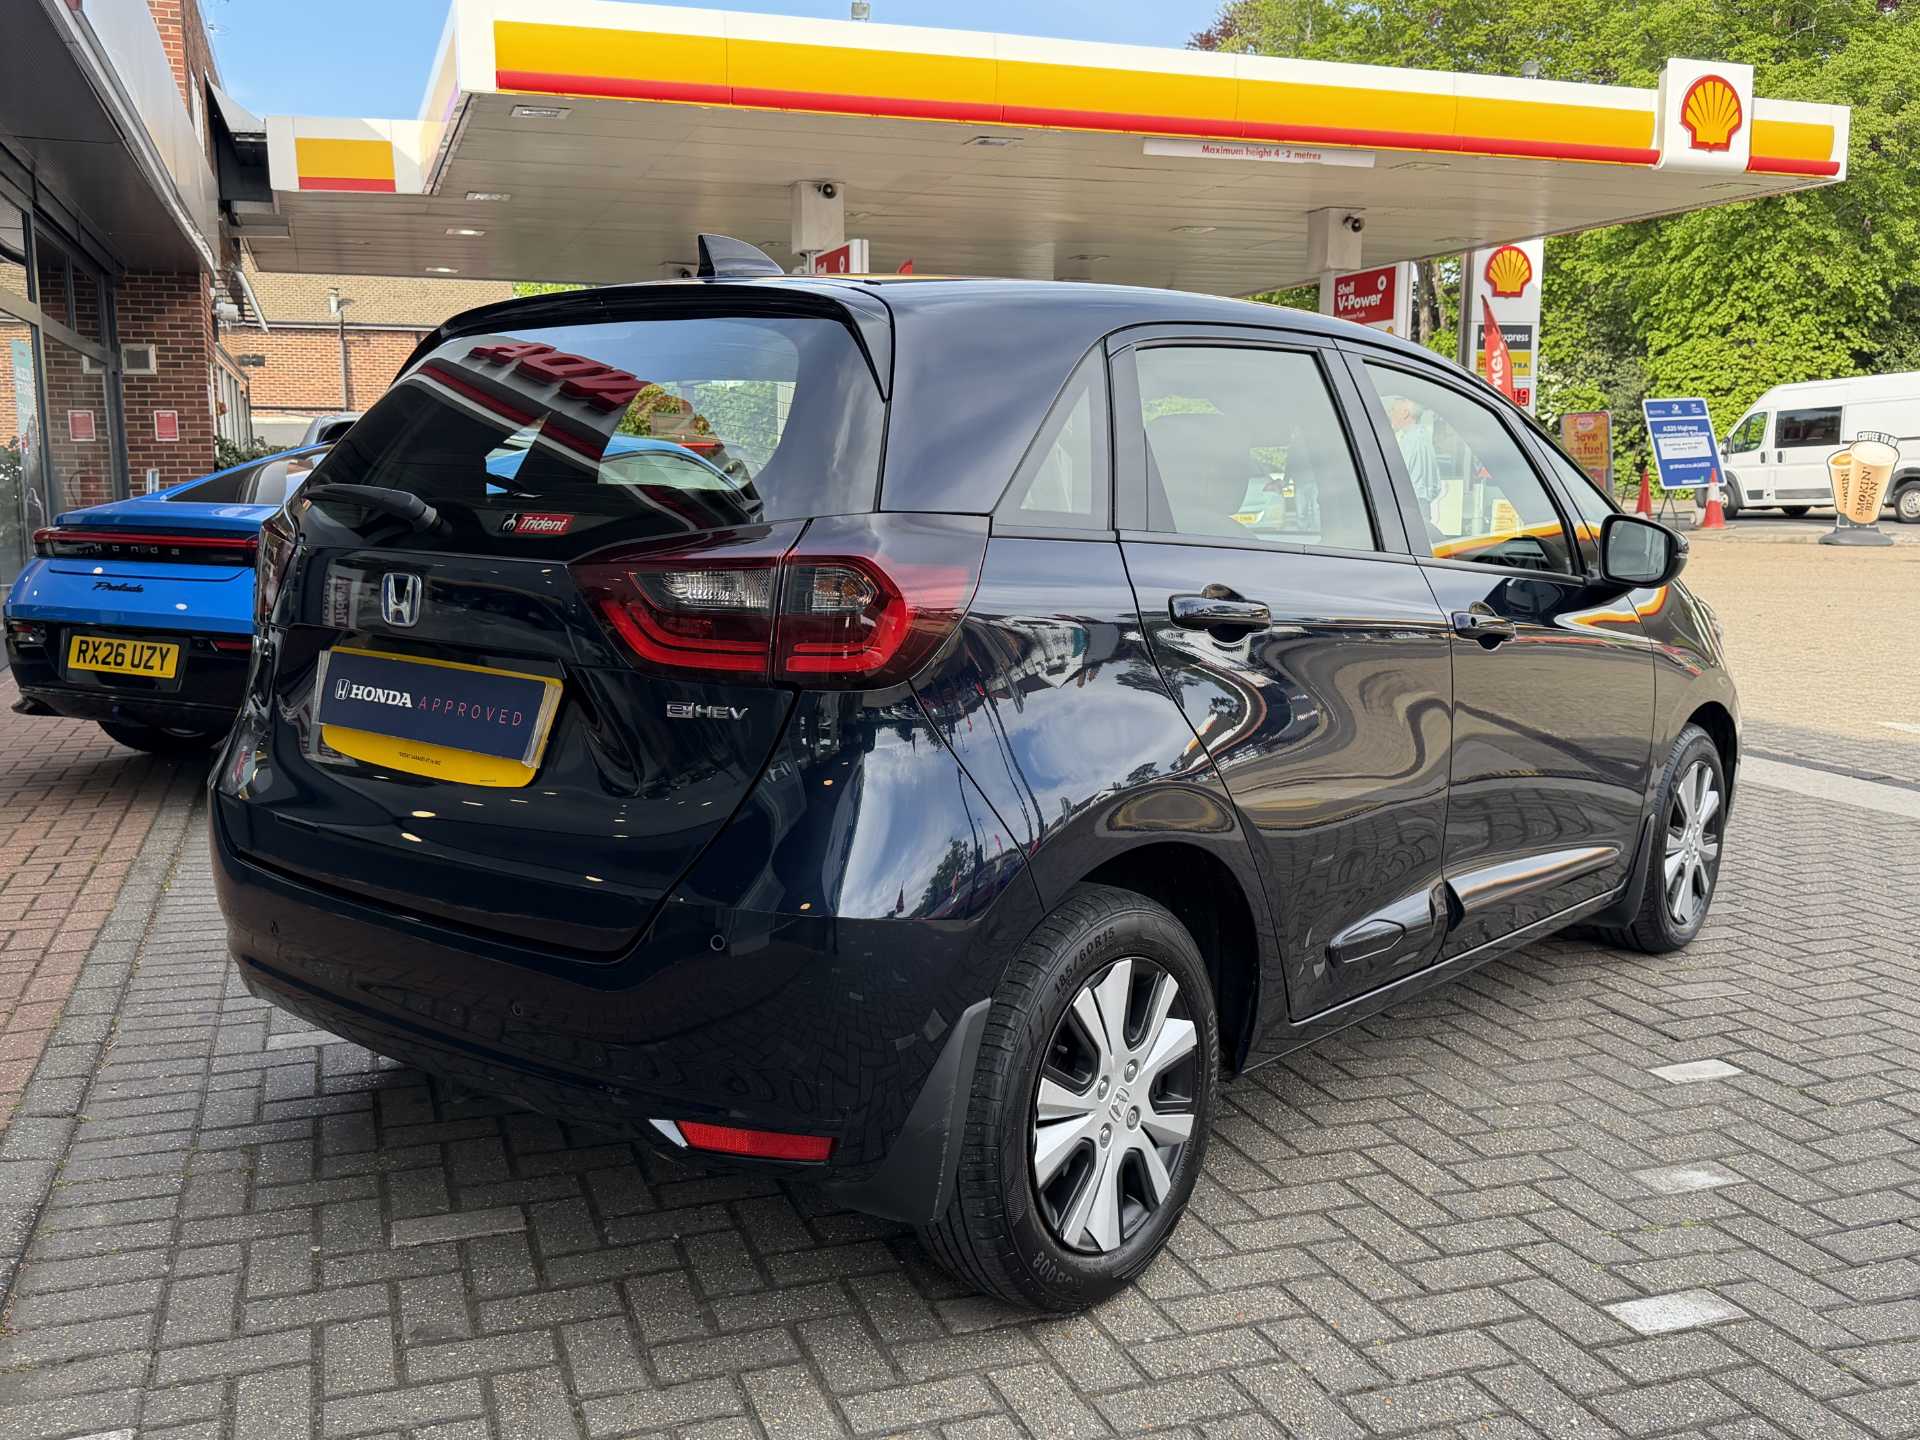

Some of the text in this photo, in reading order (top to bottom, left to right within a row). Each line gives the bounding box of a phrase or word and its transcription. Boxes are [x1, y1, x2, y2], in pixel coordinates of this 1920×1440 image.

[1201, 145, 1244, 156] Maximum
[1246, 147, 1272, 159] height
[1295, 151, 1322, 160] metres
[1338, 281, 1355, 296] Shell
[1338, 293, 1383, 312] V-Power
[1574, 432, 1599, 442] Save
[1583, 442, 1604, 455] fuel
[520, 516, 567, 531] Trident
[92, 581, 145, 593] Prelude
[76, 639, 172, 672] RX26 UZY
[350, 684, 523, 727] HONDA APPROVED
